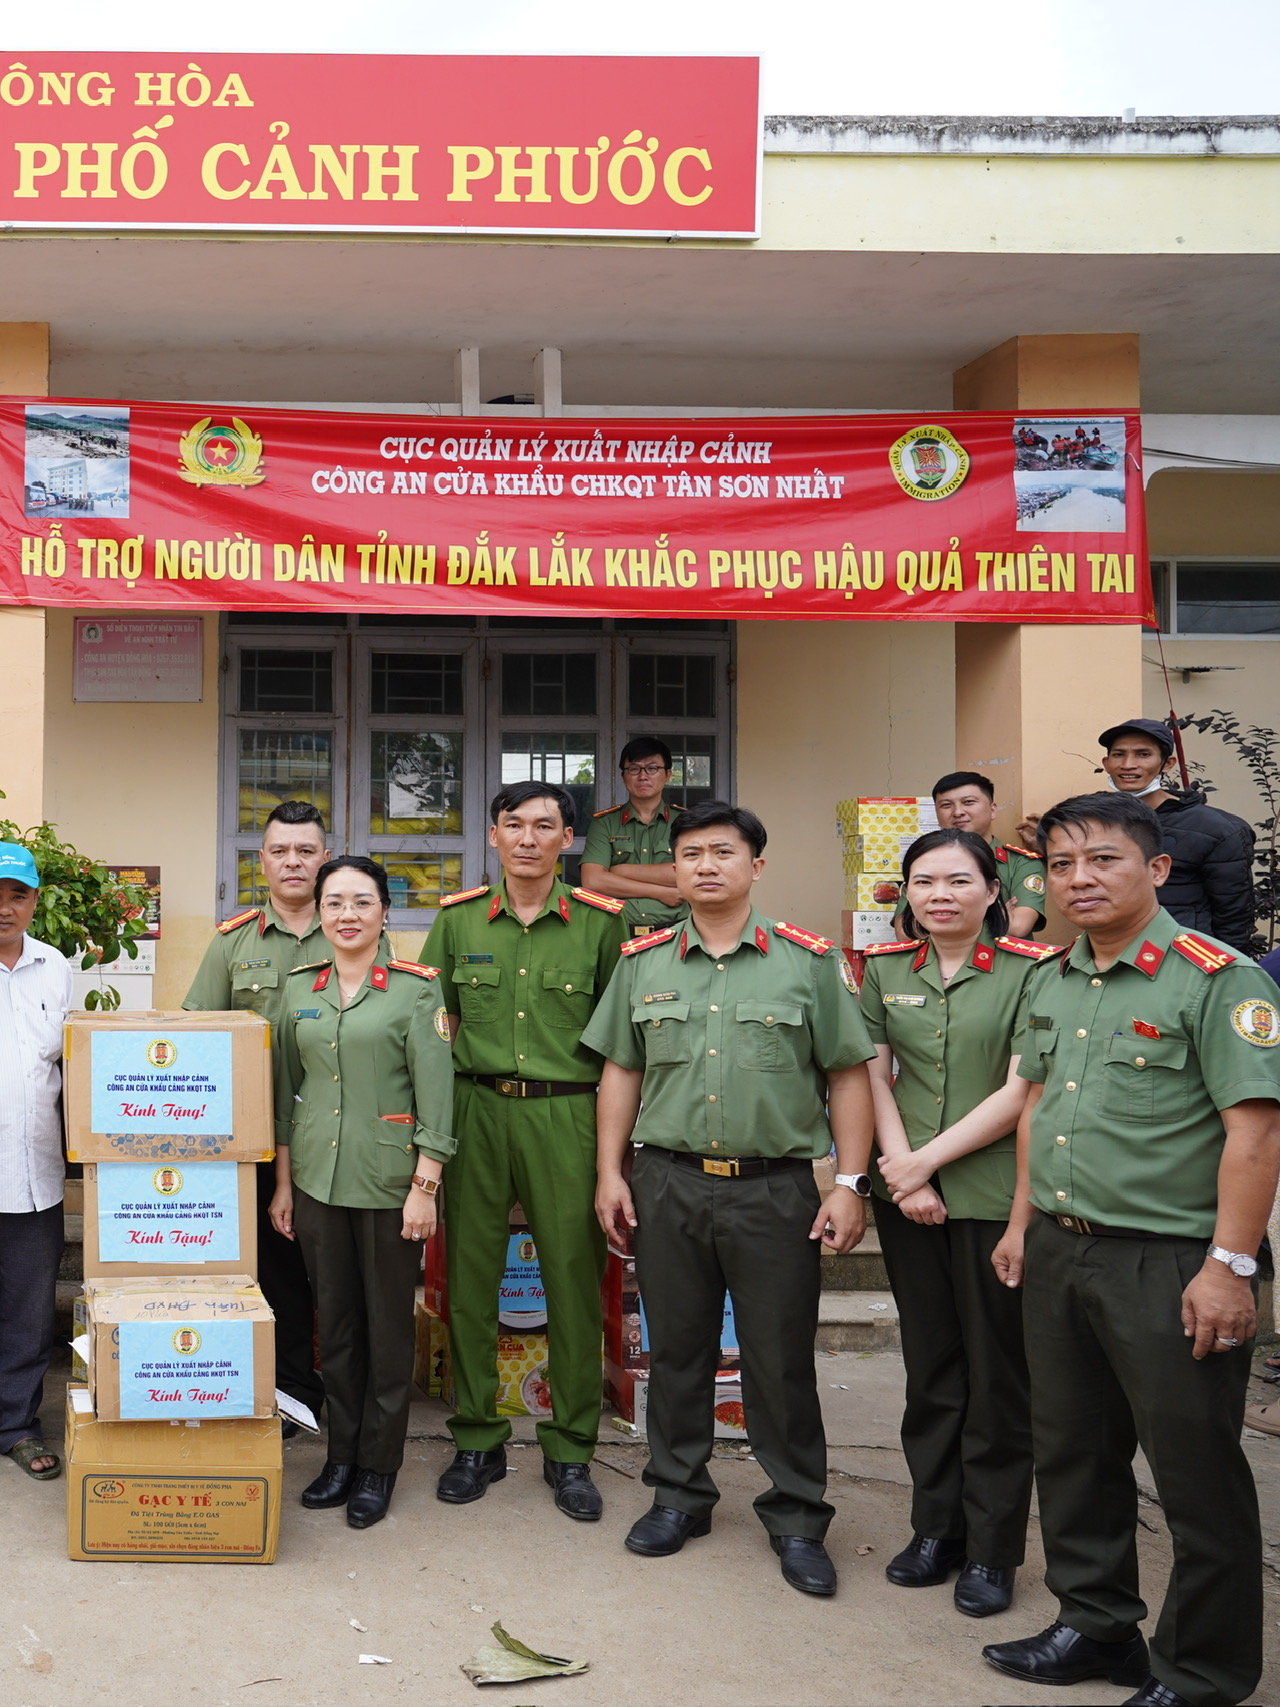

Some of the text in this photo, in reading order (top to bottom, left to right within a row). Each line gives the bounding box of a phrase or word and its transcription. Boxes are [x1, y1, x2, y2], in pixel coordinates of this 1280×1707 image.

[134, 63, 254, 107] HÒA
[14, 115, 174, 199] PHỐ
[202, 121, 419, 201] CẢNH
[447, 130, 713, 206] PHƯỚC
[380, 429, 772, 467] CỤC QUẢN LÝ XUẤT NHẬP CẢNH
[311, 464, 845, 499] CÔNG AN CỬA KHẨU CHKQT TÂN SƠN NHẤT
[900, 477, 961, 499] IMMIGRATION
[22, 524, 1135, 600] HỖ TRỢ NGƯỜI DÂN TỈNH ĐẮK LẮK KHẮC PHỤC HẬU QUẢ THIÊN TAI
[128, 1073, 146, 1081] QUẢN
[156, 1073, 171, 1081] XUẤT
[173, 1074, 190, 1082] NHẬP
[107, 1084, 216, 1092] CÔNG AN CỬA KHẨU CẢNG HKQT TSN
[117, 1103, 207, 1120] Kính Tặng!
[135, 1202, 152, 1210] QUẢN
[162, 1202, 178, 1210] XUẤT
[180, 1202, 196, 1211] NHẬP
[125, 1230, 214, 1247] Kính Tặng!
[498, 1287, 524, 1298] Kính
[630, 1346, 641, 1354] 12
[181, 1360, 196, 1368] XUẤT
[198, 1361, 214, 1370] NHẬP
[215, 1360, 232, 1368] CẢNH
[145, 1388, 230, 1404] Kính Tặng!
[139, 1495, 171, 1508] GẠC
[176, 1496, 187, 1506] Y
[192, 1492, 212, 1506] TẾ
